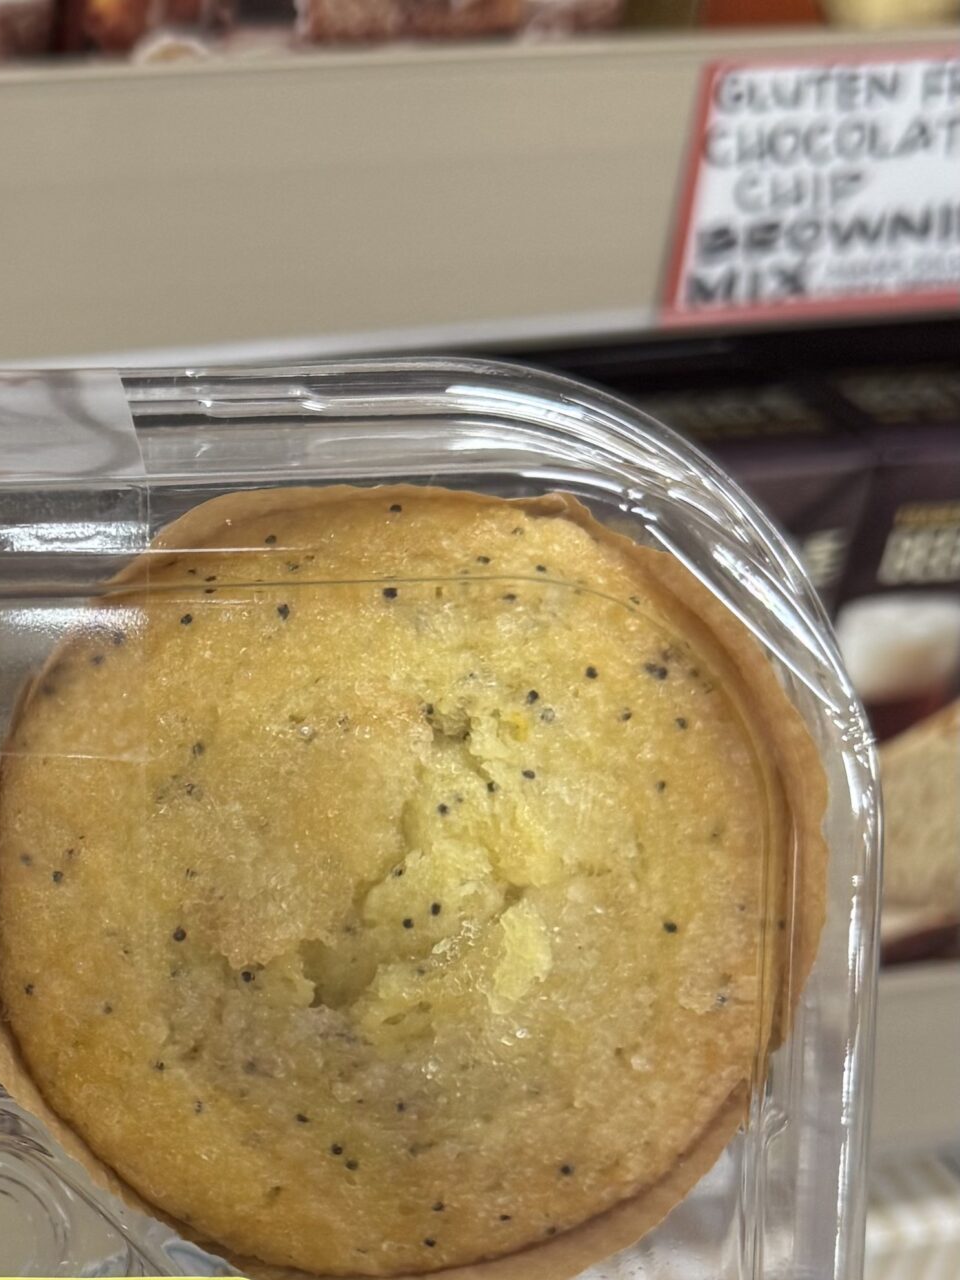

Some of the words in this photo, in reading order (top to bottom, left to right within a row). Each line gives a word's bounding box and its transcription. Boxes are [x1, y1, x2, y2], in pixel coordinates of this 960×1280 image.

[714, 68, 899, 114] GLUTEN
[732, 168, 867, 213] CHIP
[695, 203, 960, 266] BROWNI
[685, 255, 807, 309] MIX
